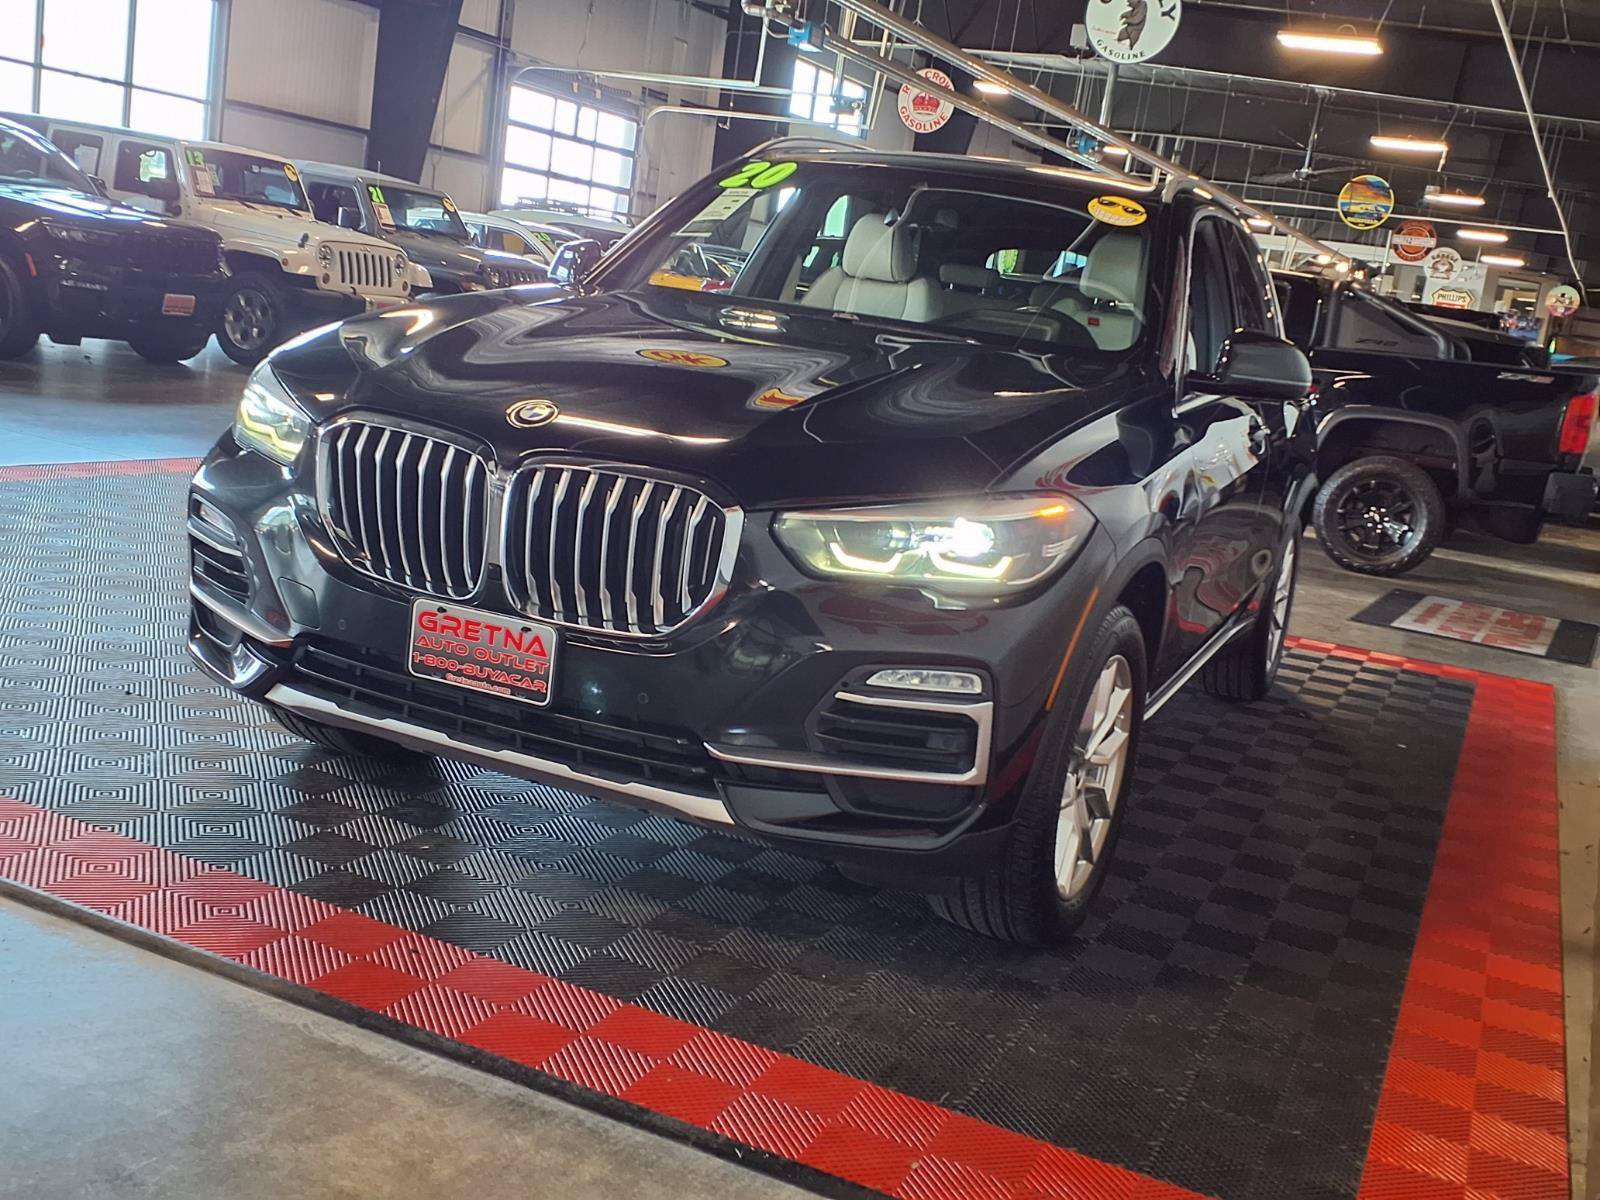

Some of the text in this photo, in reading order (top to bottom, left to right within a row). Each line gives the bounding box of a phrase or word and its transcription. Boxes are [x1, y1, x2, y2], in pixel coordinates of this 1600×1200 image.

[1096, 39, 1146, 60] GASOLINE
[900, 105, 948, 131] GASOLINE
[718, 161, 798, 189] 20
[1437, 293, 1467, 303] PHILLIPS
[418, 610, 549, 658] GRETNA
[415, 635, 550, 675] AUTO OUTLET
[413, 651, 547, 693] 1-800-BUYACAR
